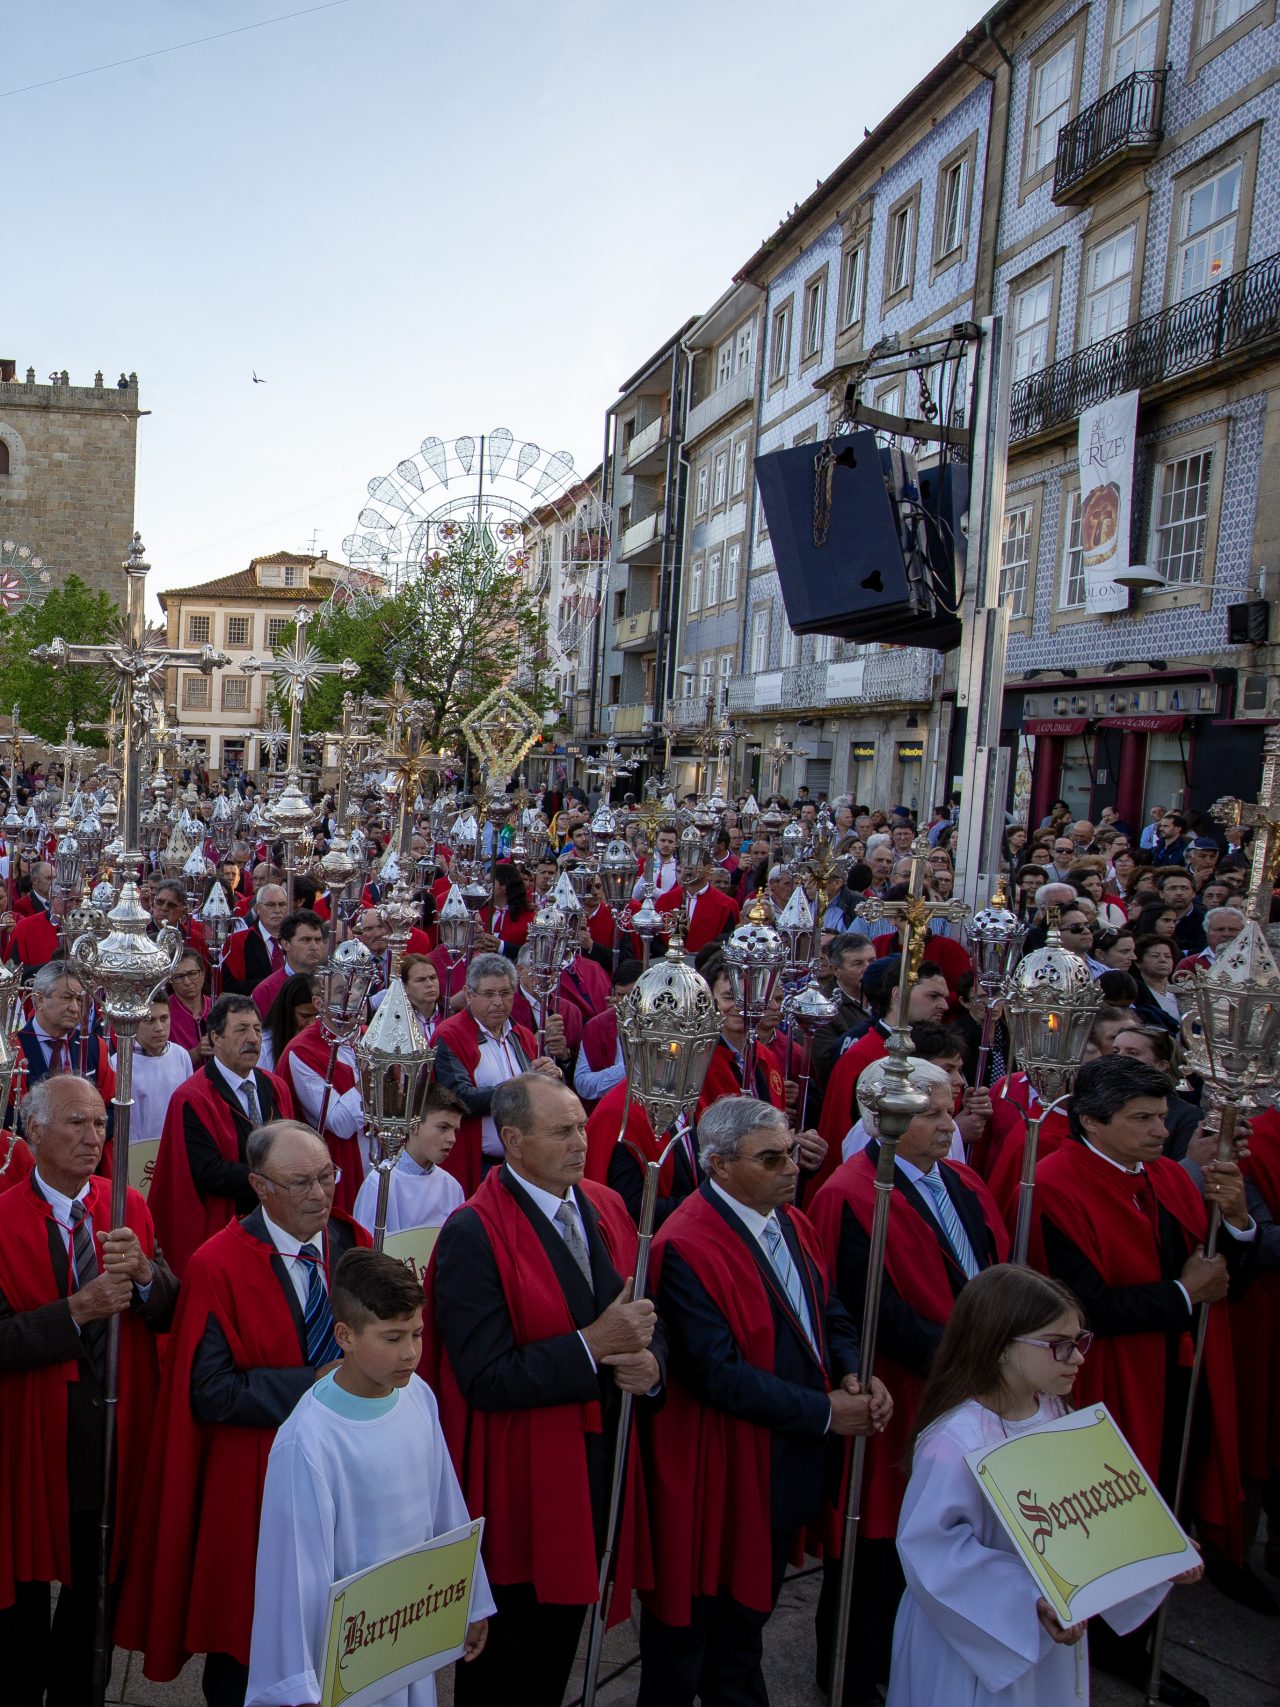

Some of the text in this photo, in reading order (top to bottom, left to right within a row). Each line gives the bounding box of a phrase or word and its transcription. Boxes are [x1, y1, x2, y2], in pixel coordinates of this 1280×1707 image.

[1081, 434, 1127, 469] CRUZES
[1053, 687, 1212, 716] COLONIAL
[1041, 723, 1072, 732] COLONIAL
[1117, 718, 1160, 729] COLONIAL
[1016, 1463, 1147, 1555] Sequeade
[342, 1576, 468, 1665] Barqueiros
